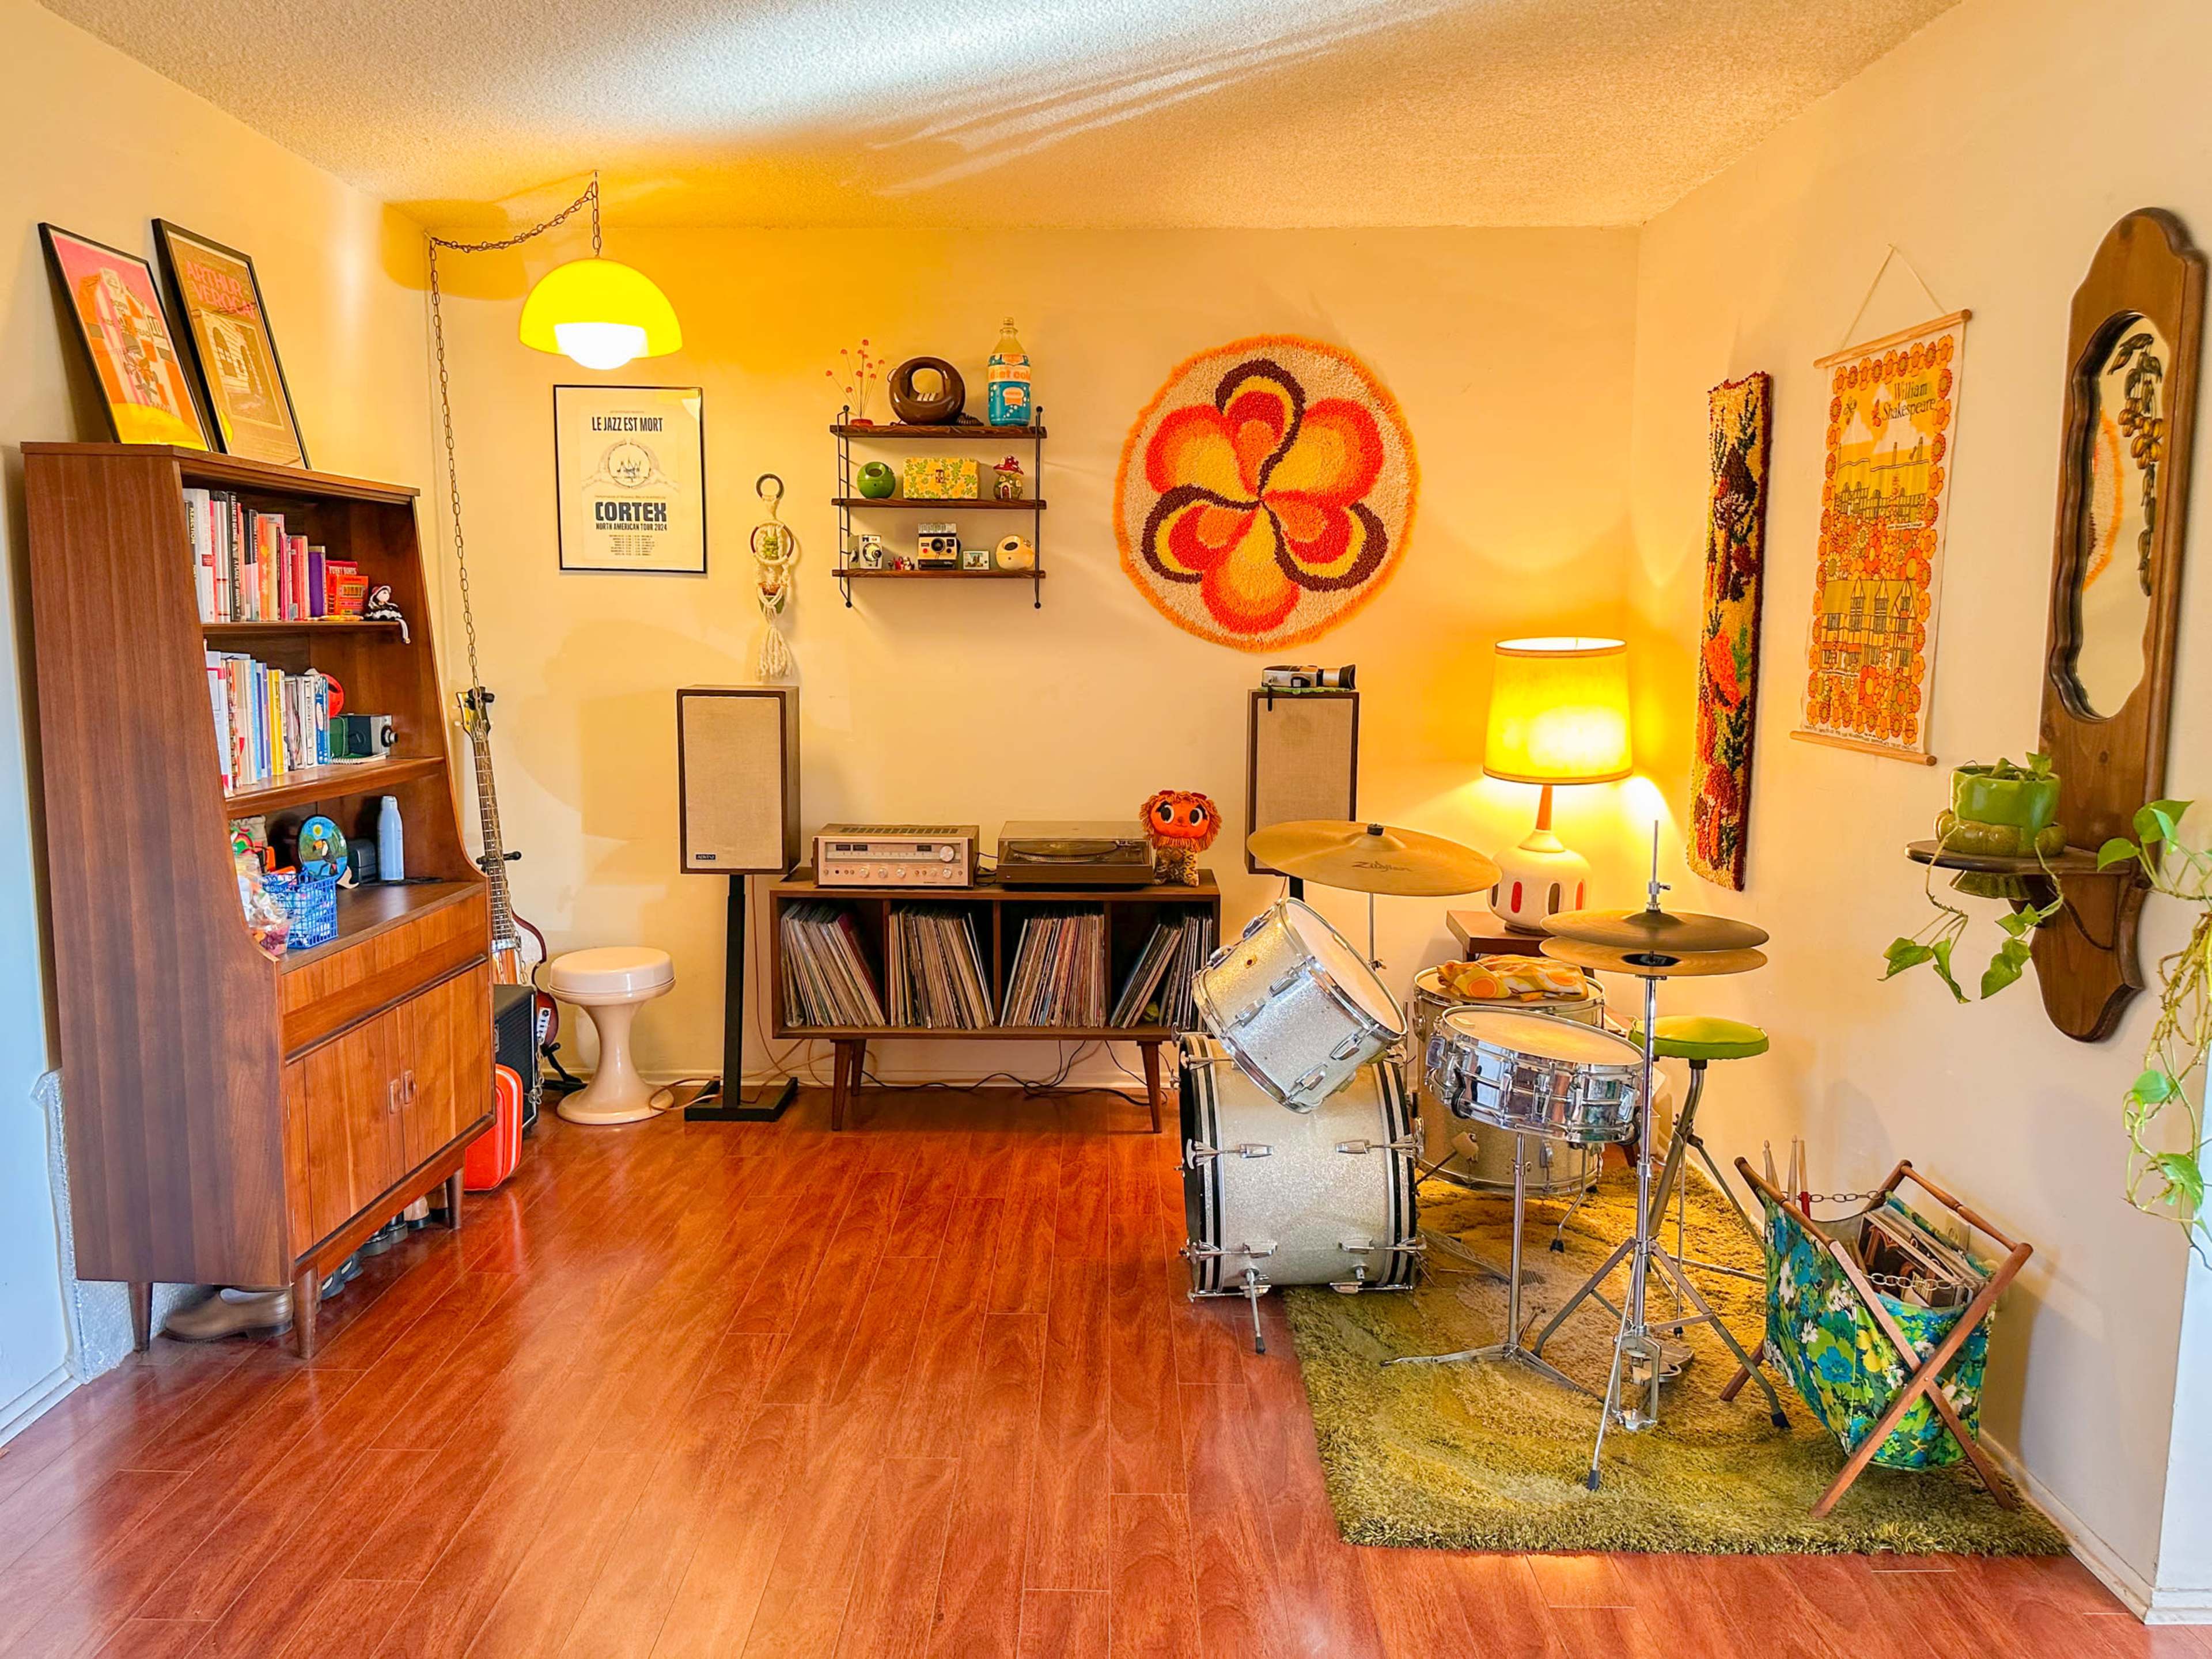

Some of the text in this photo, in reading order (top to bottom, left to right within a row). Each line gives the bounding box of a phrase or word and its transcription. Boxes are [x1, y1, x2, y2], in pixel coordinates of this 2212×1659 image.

[187, 260, 243, 298] ARTHUR
[1894, 381, 1927, 400] William
[1882, 398, 1937, 421] Shakespeare
[592, 416, 663, 432] LE JAZZ EST MORT
[595, 502, 666, 522] CORTEX
